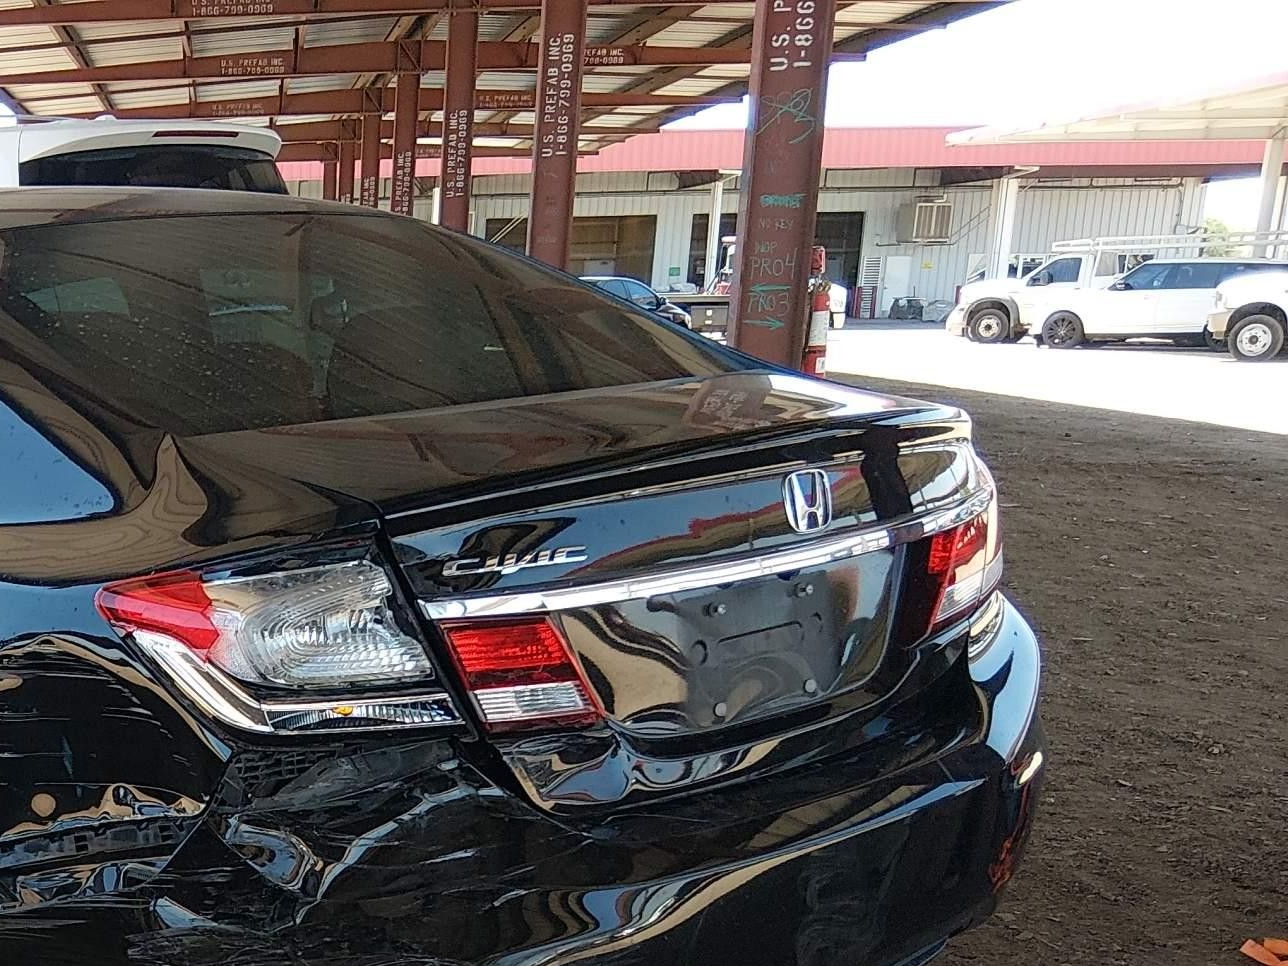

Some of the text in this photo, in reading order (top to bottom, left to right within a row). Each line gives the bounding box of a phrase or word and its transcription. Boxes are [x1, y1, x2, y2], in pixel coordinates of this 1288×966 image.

[769, 26, 791, 71] U.S.
[541, 33, 561, 158] U.S. PREFAB INC.
[555, 33, 574, 155] 1-866-799-0969
[447, 134, 457, 173] PREFAB
[442, 545, 589, 577] CIVIC
